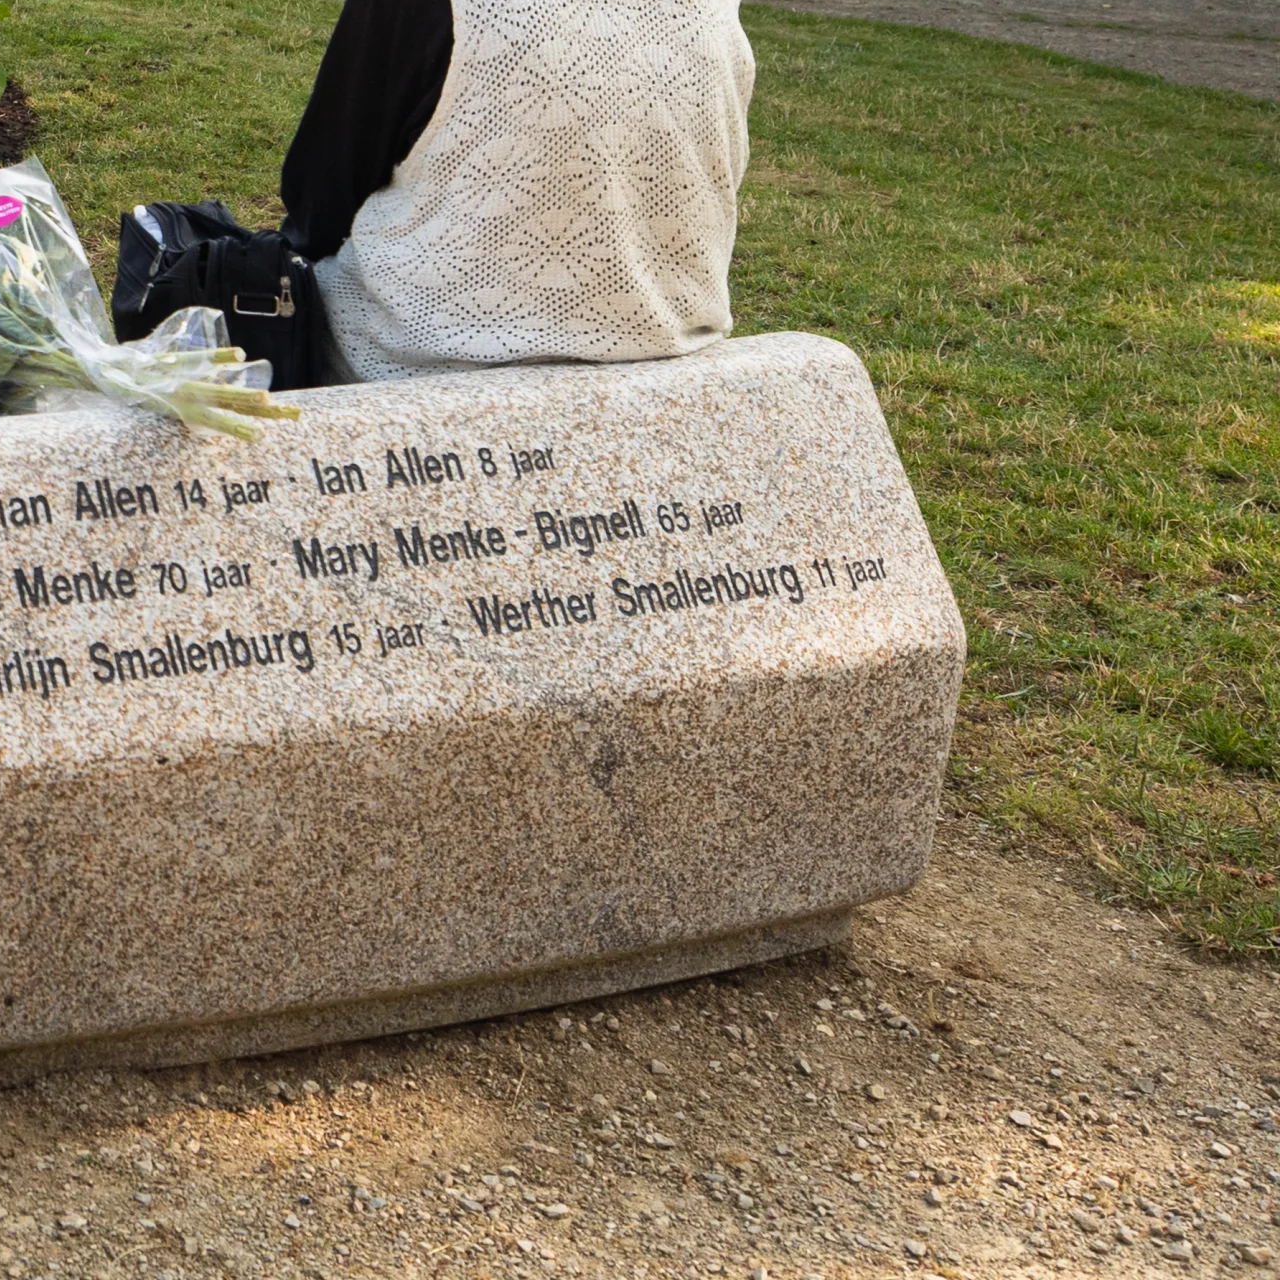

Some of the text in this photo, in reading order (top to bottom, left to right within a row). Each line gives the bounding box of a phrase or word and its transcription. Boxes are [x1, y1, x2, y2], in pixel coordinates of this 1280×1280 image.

[74, 478, 160, 522] Allen
[173, 478, 207, 511] 14
[220, 476, 271, 515] jaar
[312, 457, 368, 497] Ian
[385, 446, 467, 489] Allen
[478, 447, 499, 478] 8
[508, 442, 557, 481] jaar
[13, 560, 137, 610] Menke
[151, 561, 189, 595] 70
[201, 560, 252, 597] jaar
[293, 536, 381, 583] Mary
[656, 501, 691, 535] 65
[700, 498, 745, 536] jaar
[90, 628, 317, 684] Smallenburg
[329, 622, 364, 657] 15
[376, 618, 427, 659] jaar
[468, 587, 599, 639] Werther
[612, 559, 804, 620] Smallenburg
[811, 556, 836, 588] 11
[843, 551, 890, 589] jaar
